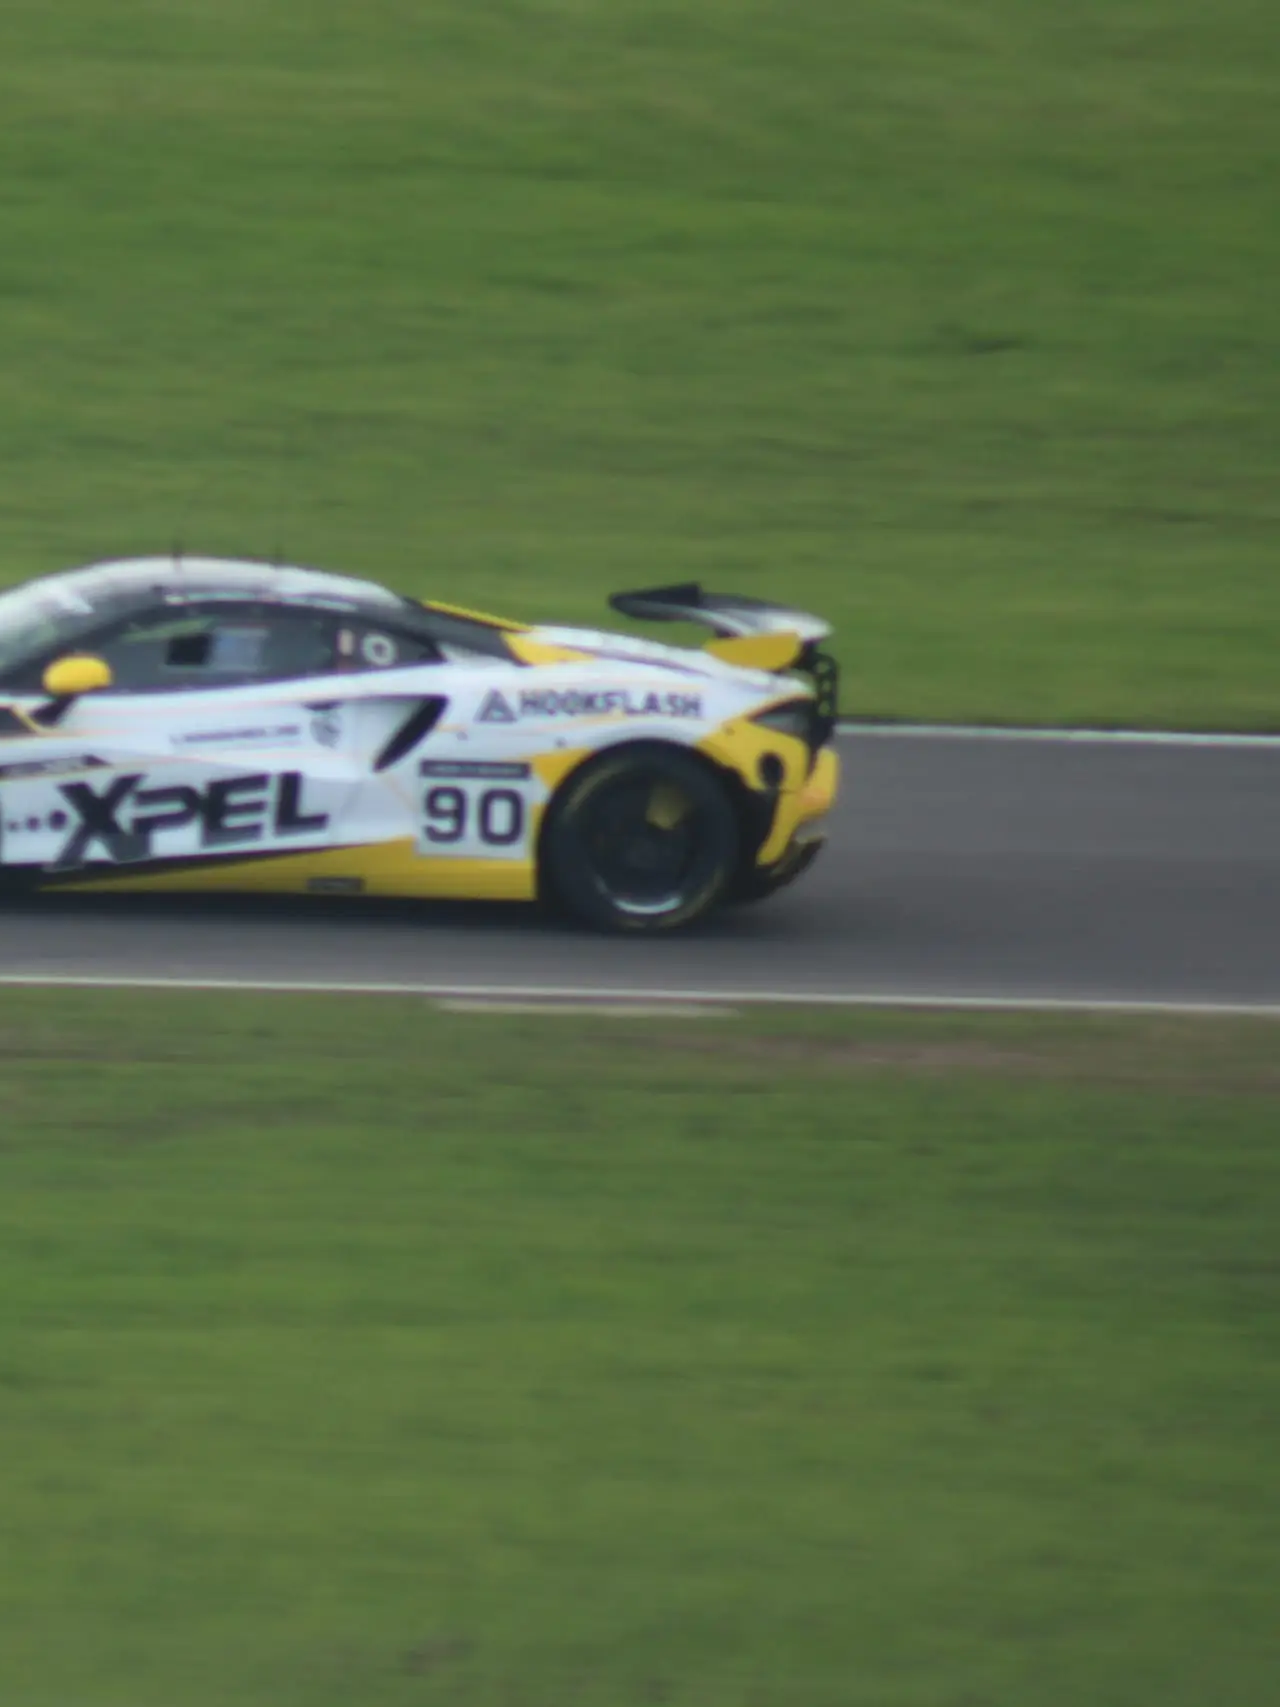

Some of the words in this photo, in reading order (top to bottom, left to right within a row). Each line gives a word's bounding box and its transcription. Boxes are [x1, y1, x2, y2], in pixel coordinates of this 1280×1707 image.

[519, 689, 704, 720] HOOKFLASH
[44, 771, 329, 870] XPEL
[424, 786, 526, 847] 90
